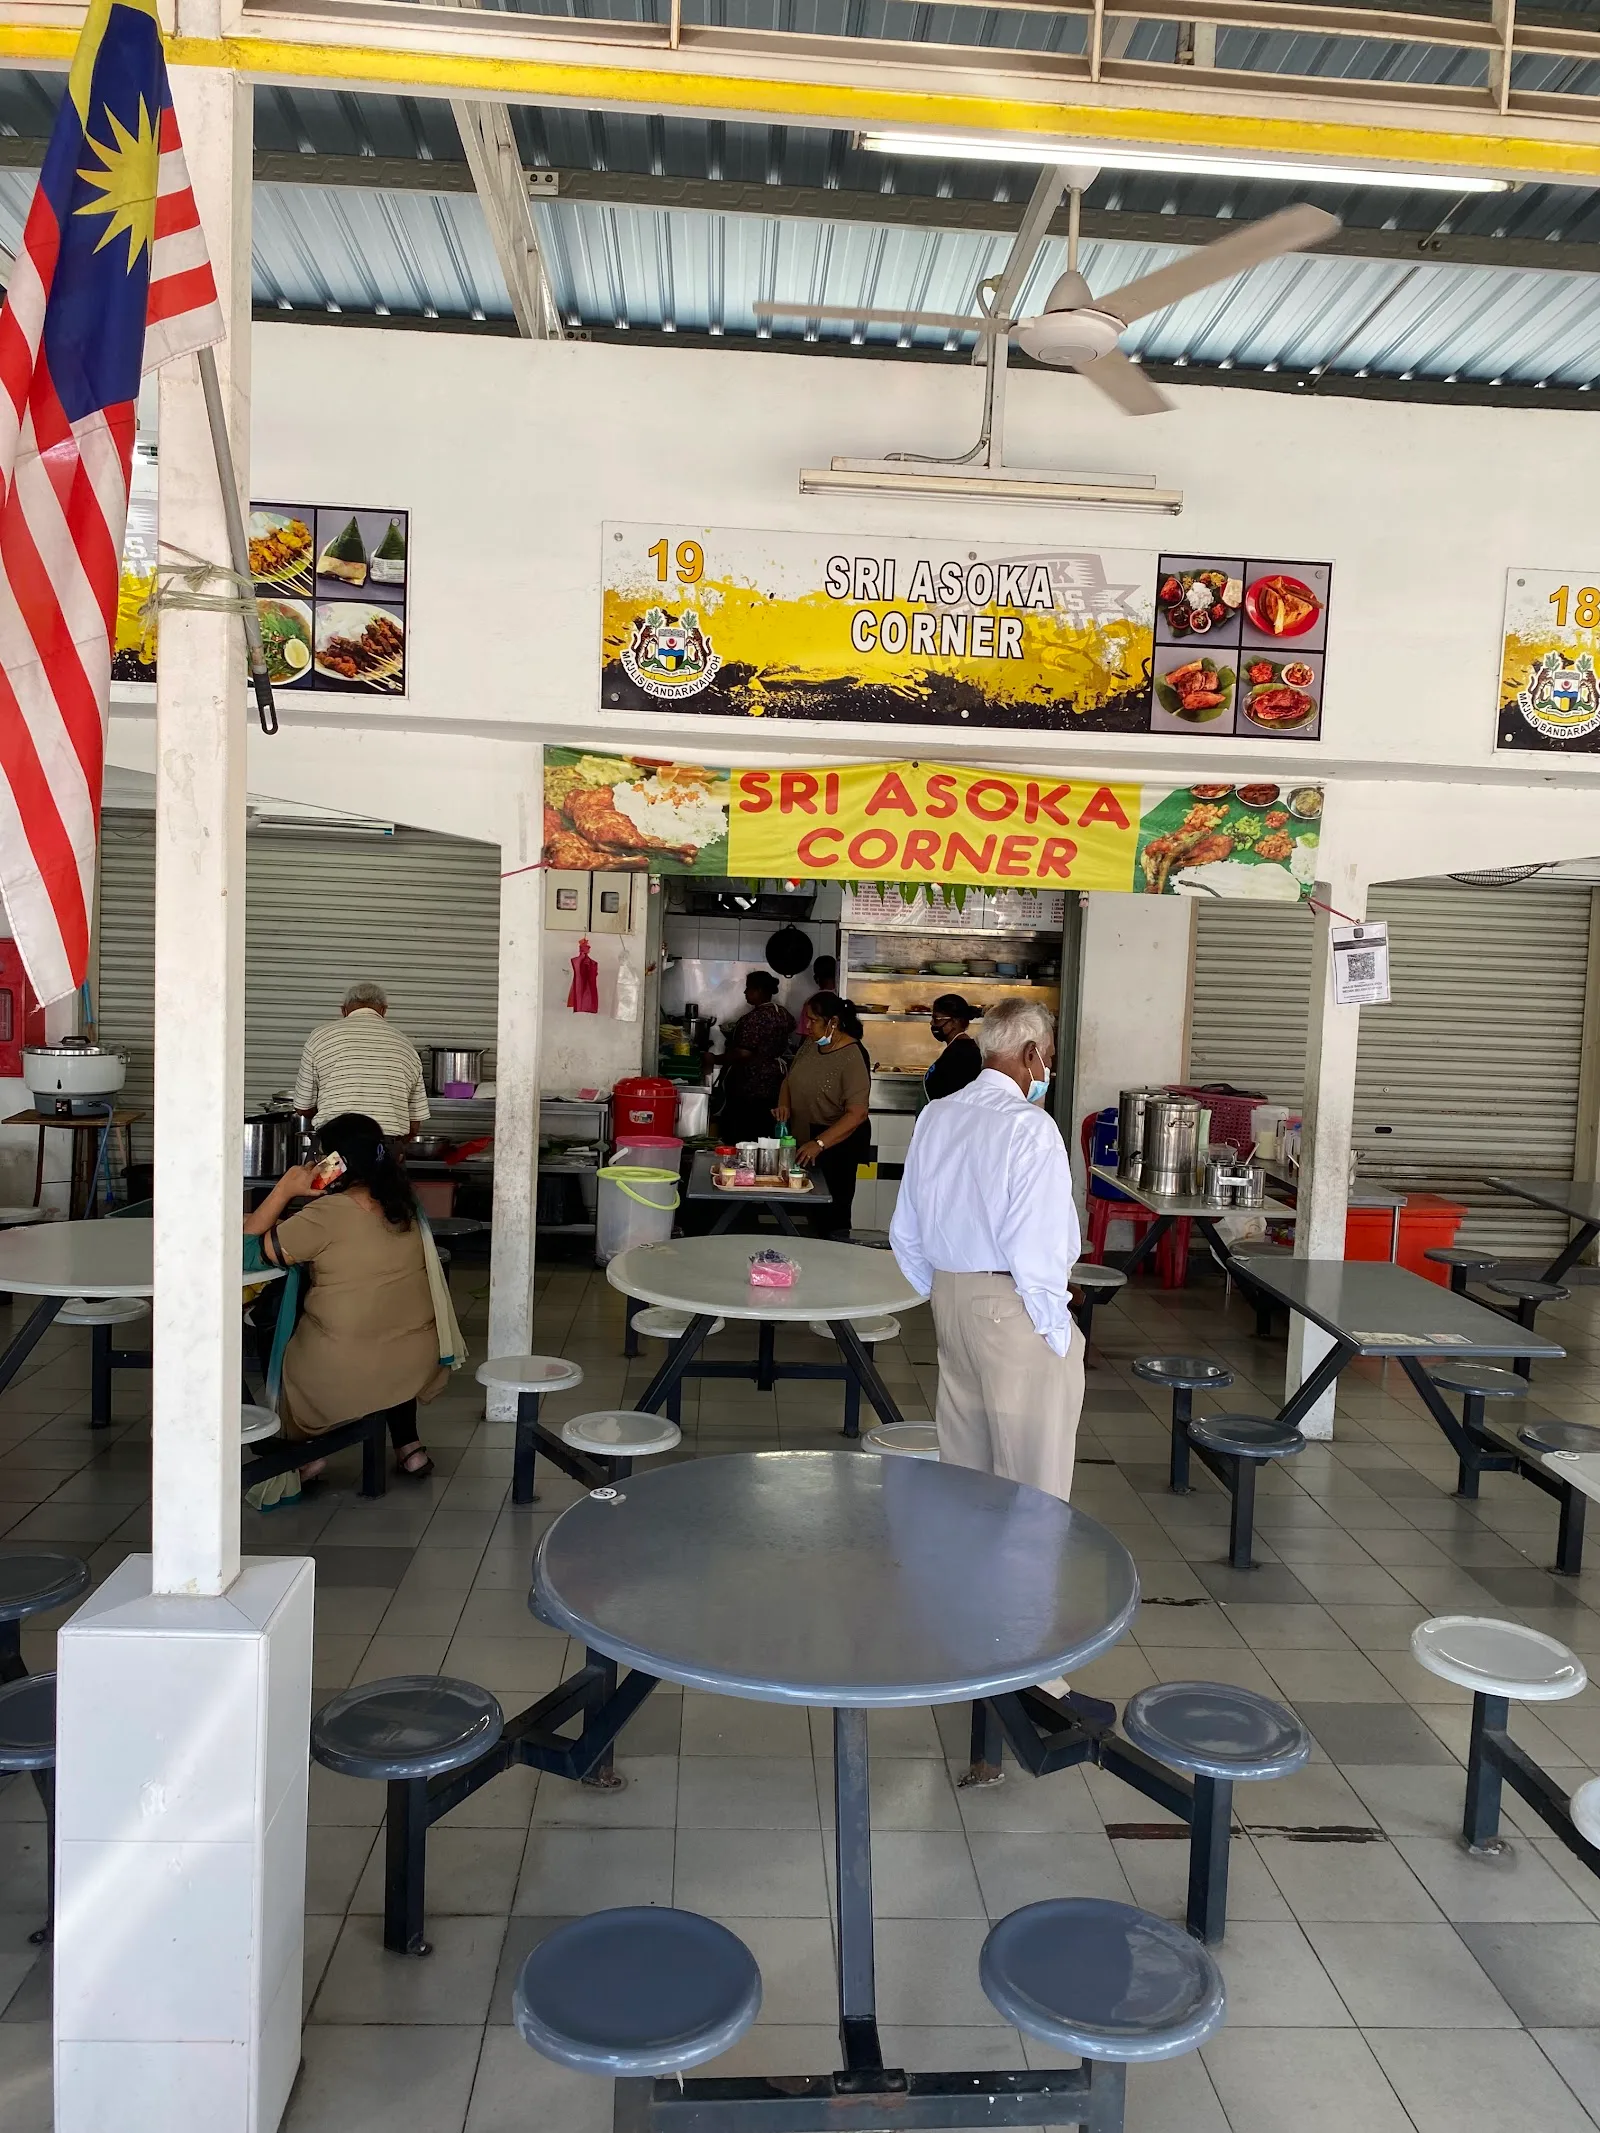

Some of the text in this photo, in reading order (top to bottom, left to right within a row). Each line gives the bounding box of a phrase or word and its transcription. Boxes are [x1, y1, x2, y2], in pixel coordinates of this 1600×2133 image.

[647, 538, 706, 584] 19
[825, 555, 896, 603] SRI
[907, 559, 1054, 610] ASOKA
[1549, 585, 1600, 629] 18
[849, 611, 1025, 660] CORNER
[622, 651, 721, 697] MAJLIS BANDARAYA IPOH
[1519, 692, 1597, 738] MAJLIS BANDARAYA
[738, 771, 1131, 831] SRI ASOKA
[797, 826, 1079, 879] CORNER
